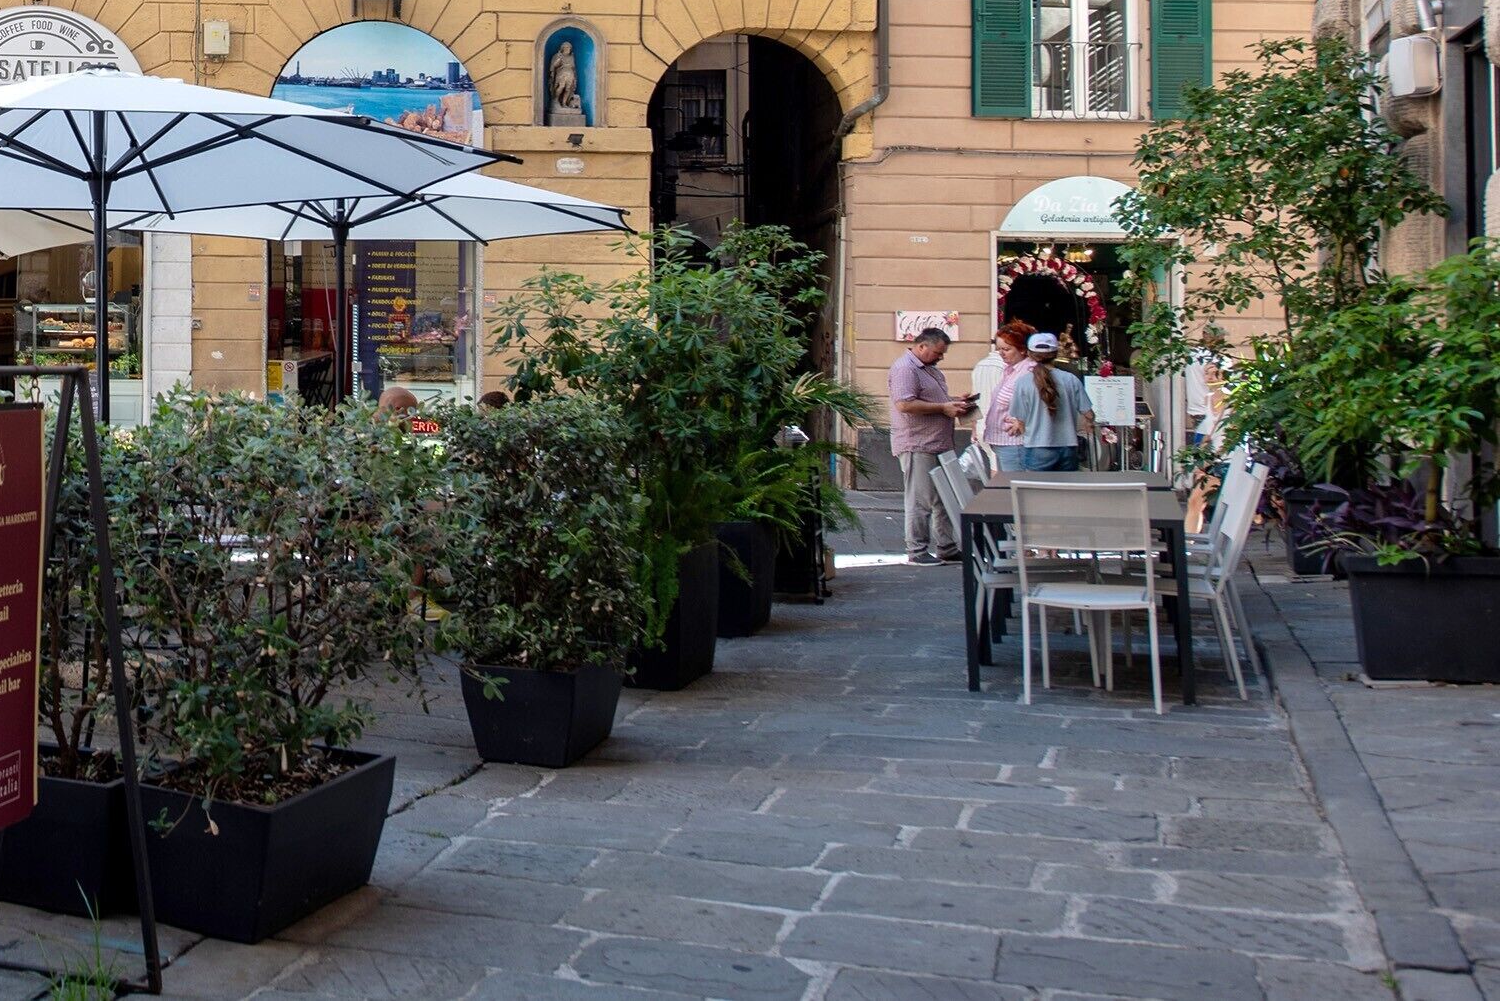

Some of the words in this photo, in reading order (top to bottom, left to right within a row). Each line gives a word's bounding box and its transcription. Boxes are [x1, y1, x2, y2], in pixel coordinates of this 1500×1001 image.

[31, 20, 52, 30] FOOD
[59, 24, 80, 41] WINE
[1034, 195, 1061, 212] Da
[1069, 196, 1098, 213] Zia
[1040, 213, 1081, 224] Gelateria
[1083, 215, 1119, 225] artigian
[412, 421, 441, 432] ERTO
[5, 511, 37, 525] MARESCOTTI
[8, 677, 21, 692] bar
